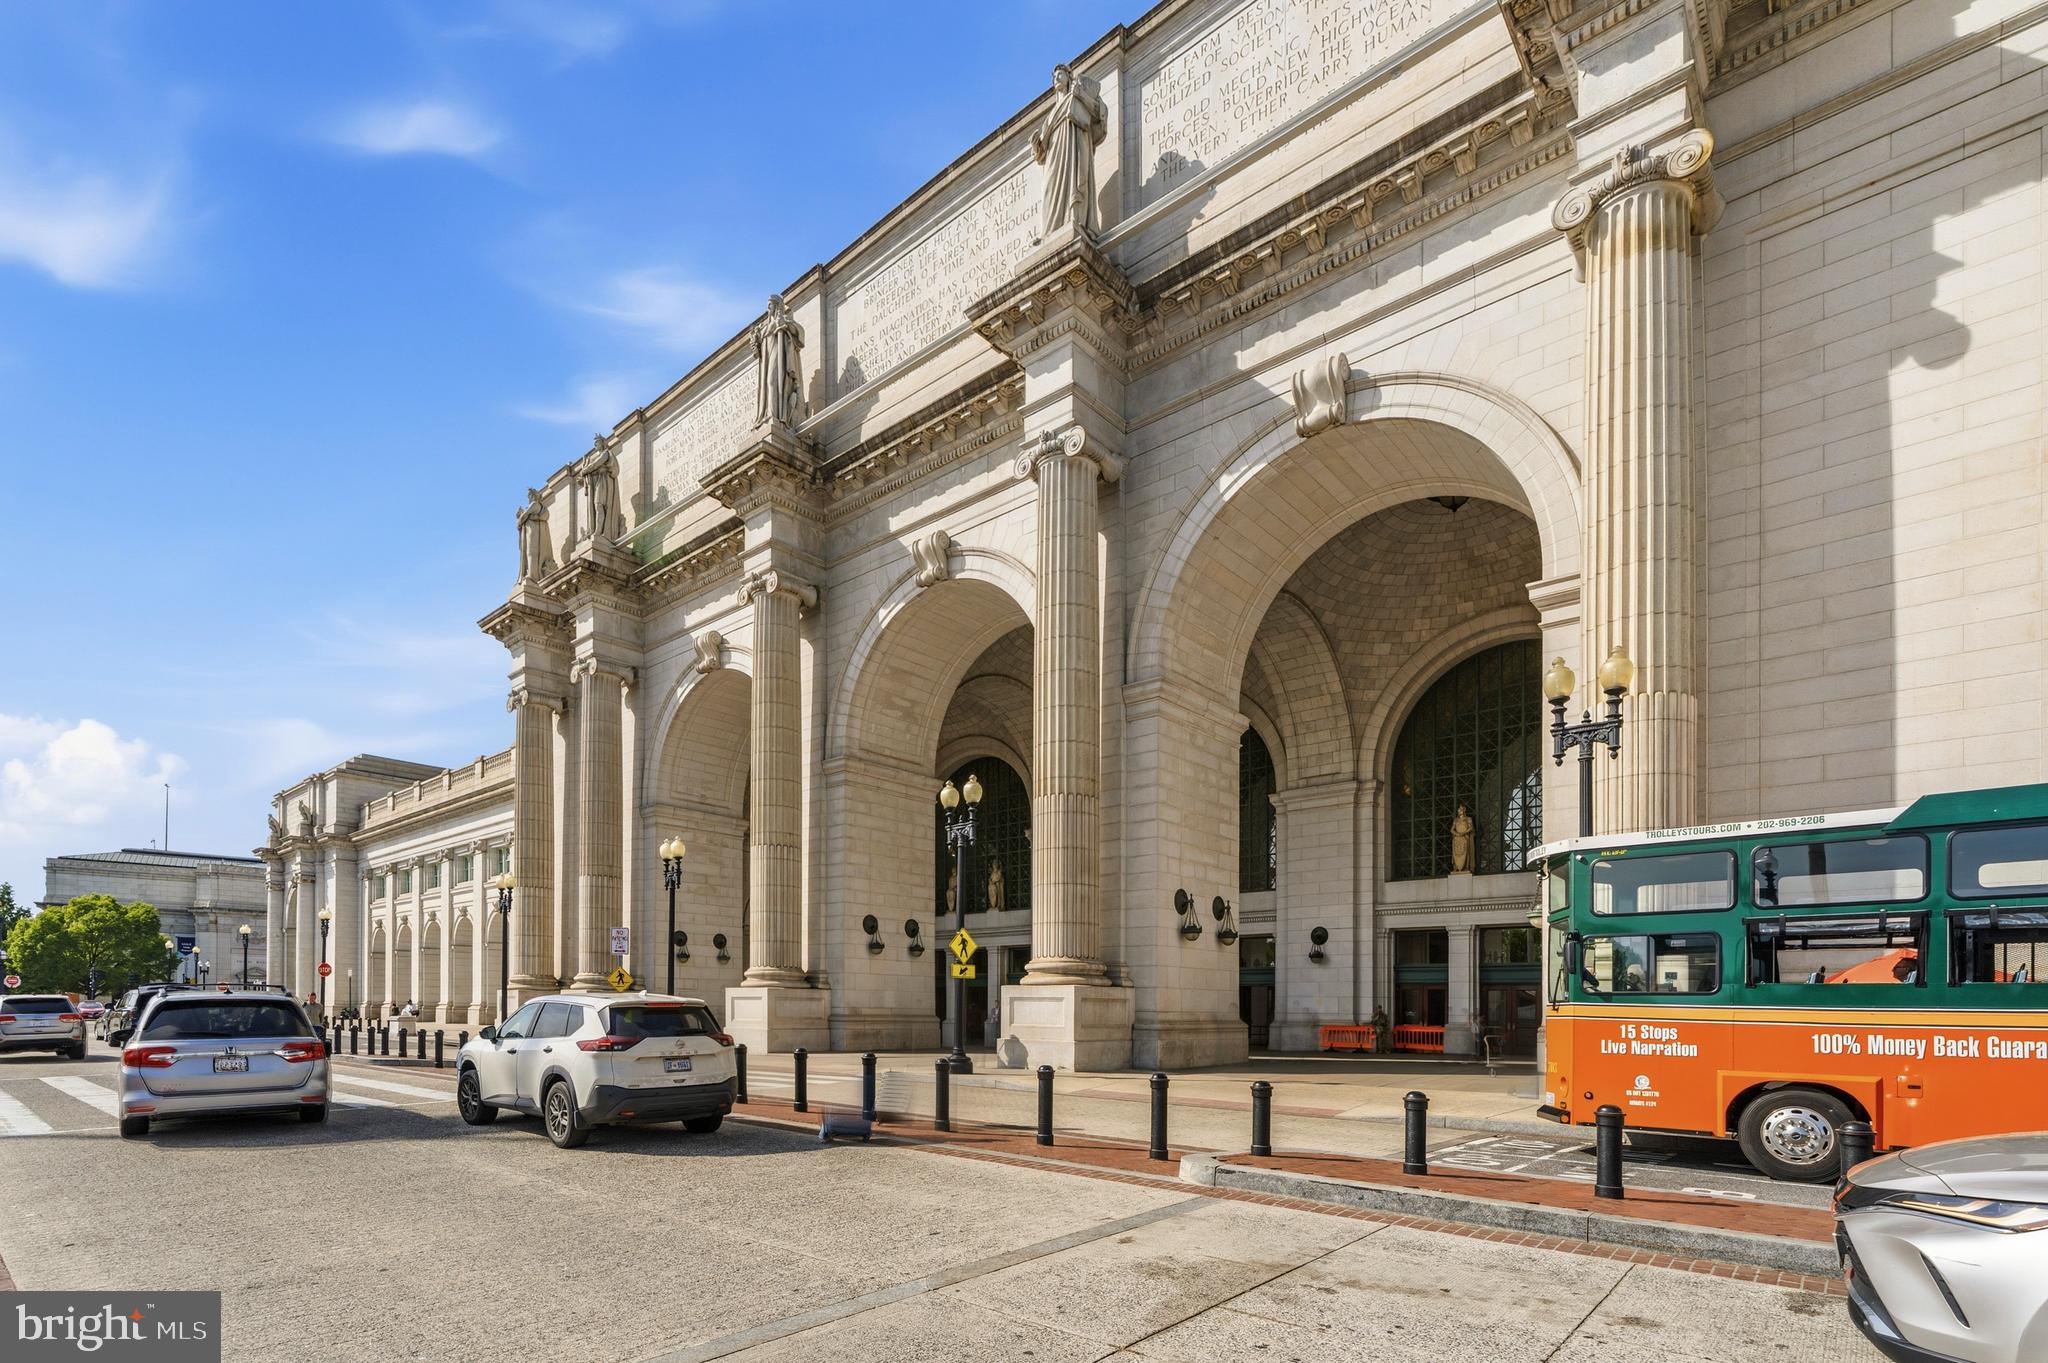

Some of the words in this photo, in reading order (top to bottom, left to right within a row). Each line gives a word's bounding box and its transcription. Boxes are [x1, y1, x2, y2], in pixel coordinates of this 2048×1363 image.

[1143, 67, 1197, 111] SOURCE
[1204, 49, 1222, 67] OF
[1230, 0, 1304, 50] NATIONA
[1145, 71, 1212, 124] CIVILIZED
[1220, 18, 1284, 72] SOCIETY
[1149, 121, 1175, 146] THE
[1183, 98, 1211, 122] OLD
[1219, 35, 1300, 97] MECHANIC
[1309, 1, 1352, 40] ARTS
[1151, 66, 1175, 91] THE
[1183, 33, 1221, 69] FARM
[1237, 0, 1272, 30] BEST
[1158, 112, 1211, 155] FORCES
[1222, 75, 1267, 113] BUILD
[1276, 43, 1312, 78] NEW
[1321, 0, 1394, 48] HIGHWA
[1161, 157, 1186, 183] THE
[1193, 130, 1231, 160] VERY
[1240, 93, 1288, 133] ETHER
[1297, 49, 1353, 95] CARRY
[1364, 0, 1432, 54] HUMAN
[1150, 149, 1179, 173] AND
[1188, 123, 1218, 152] MEN
[1233, 62, 1309, 120] OVERRIDE
[1320, 34, 1352, 64] THE
[865, 251, 914, 297] SWEETENER
[918, 245, 929, 258] OF
[982, 194, 995, 211] OF
[1000, 173, 1026, 199] HALL
[876, 277, 917, 313] FREEDOM
[932, 238, 971, 273] FAIREST
[975, 225, 988, 239] OF
[993, 210, 1013, 228] ALL
[943, 231, 962, 252] OUT
[967, 221, 979, 235] OF
[985, 184, 1028, 220] NAUGHT
[850, 322, 867, 341] THE
[871, 285, 922, 327] DAUGHTERS
[926, 274, 938, 288] OF
[943, 257, 965, 277] TIME
[969, 237, 990, 258] AND
[879, 297, 935, 340] IMAGINATION
[938, 280, 958, 301] HAS
[962, 239, 1021, 284] CONCEIVED
[905, 303, 944, 334] LETTERS
[953, 285, 971, 304] ALL
[976, 259, 1007, 287] TOOLS
[913, 317, 940, 341] EVERY
[945, 300, 963, 320] ART
[967, 285, 988, 305] AND
[1646, 823, 1741, 839] TROLLEYSTOURS.COM
[1601, 1039, 1627, 1054] Live
[1631, 1040, 1698, 1057] Narration
[1620, 1024, 1637, 1039] 15
[1640, 1024, 1678, 1041] Stops
[1812, 1034, 1861, 1055] 100%
[1867, 1035, 1926, 1060] Money
[1933, 1036, 1980, 1058] Back
